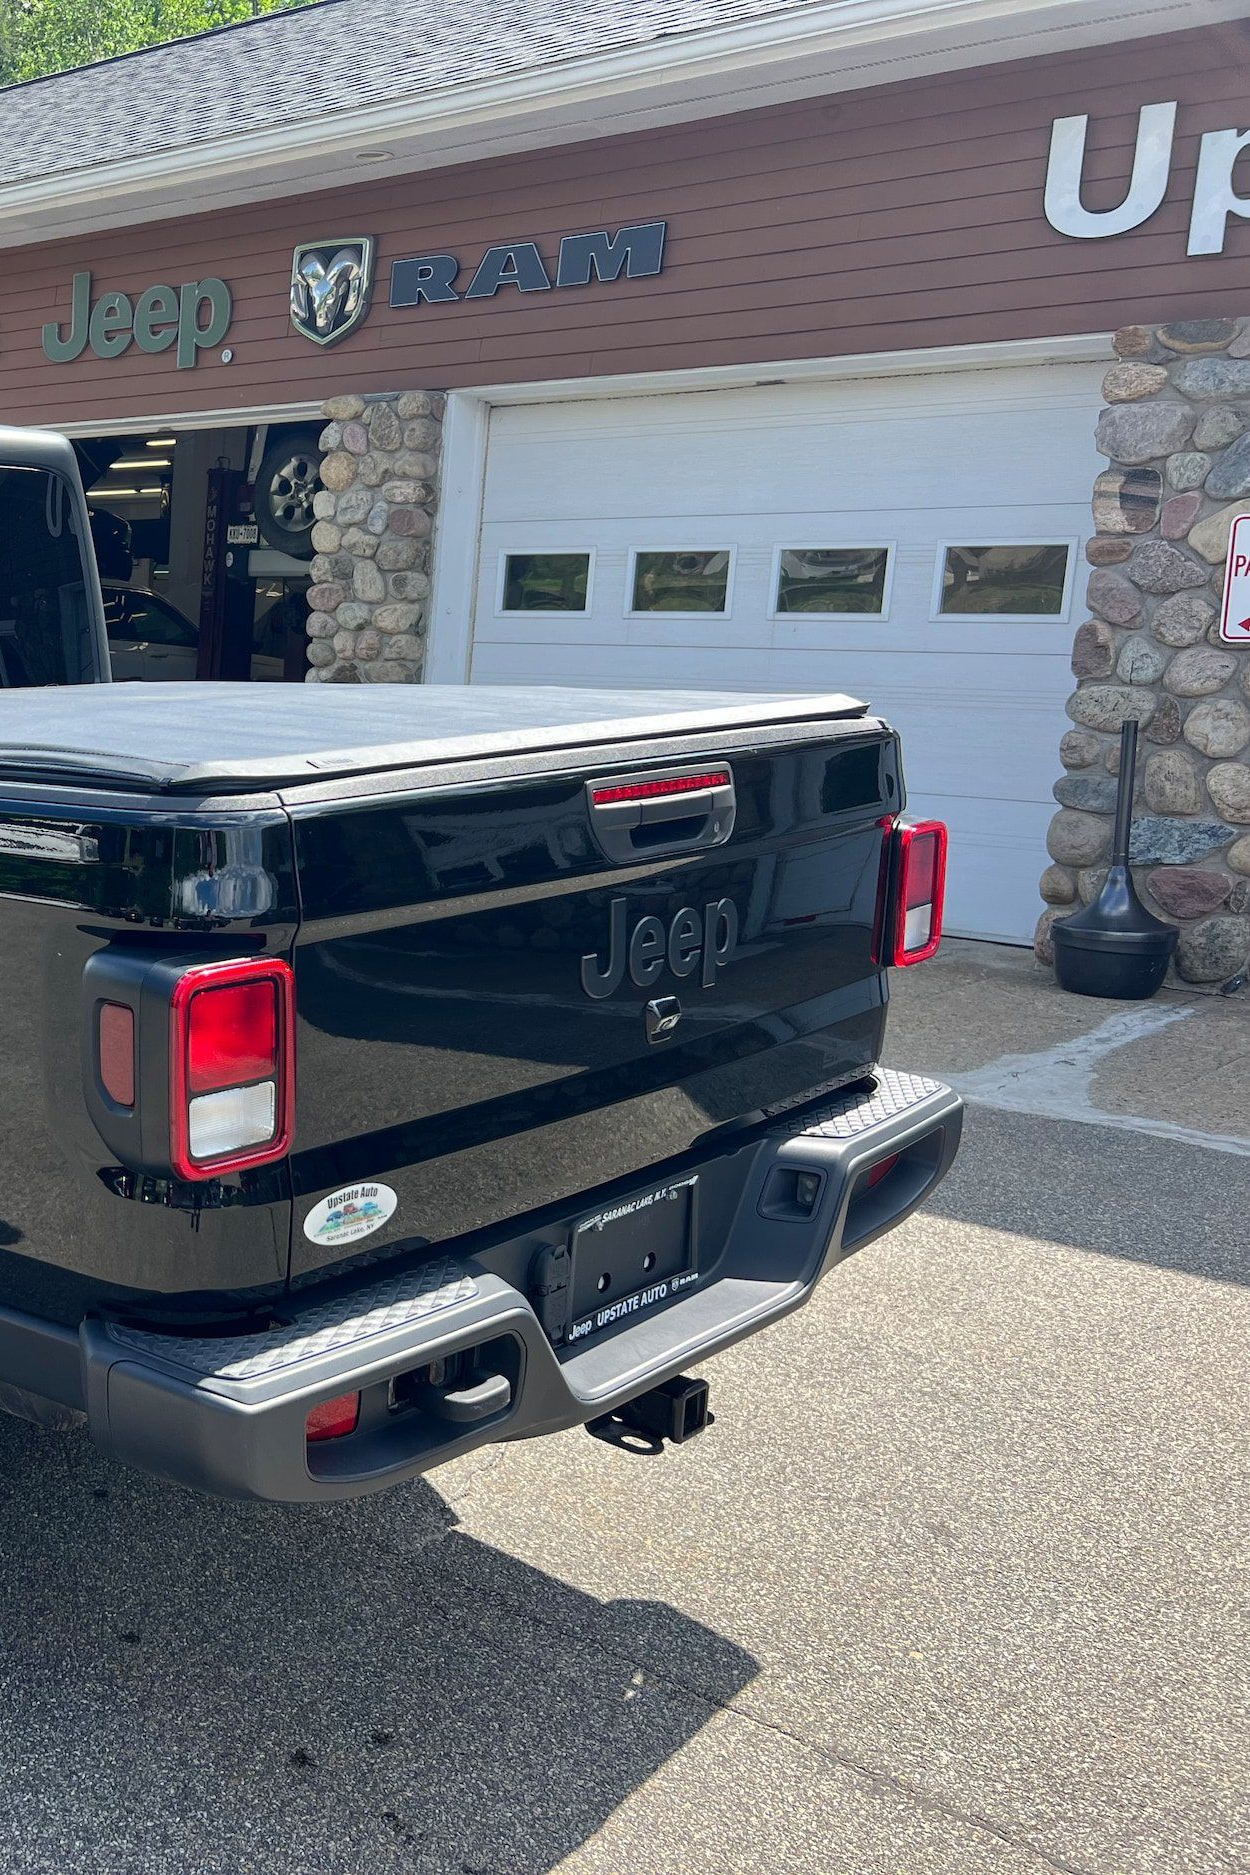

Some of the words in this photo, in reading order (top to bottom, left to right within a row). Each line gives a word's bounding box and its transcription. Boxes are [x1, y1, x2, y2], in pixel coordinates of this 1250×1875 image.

[389, 221, 667, 309] RAM
[42, 271, 232, 369] Jeep
[203, 505, 217, 586] MOHAWK
[581, 897, 739, 999] Jeep
[327, 1189, 358, 1209] Upstate
[360, 1186, 378, 1198] Auto
[602, 1202, 636, 1223] SARANAC
[569, 1319, 592, 1341] Jeep
[597, 1295, 639, 1327] UPSTATE
[640, 1283, 667, 1307] AUTO
